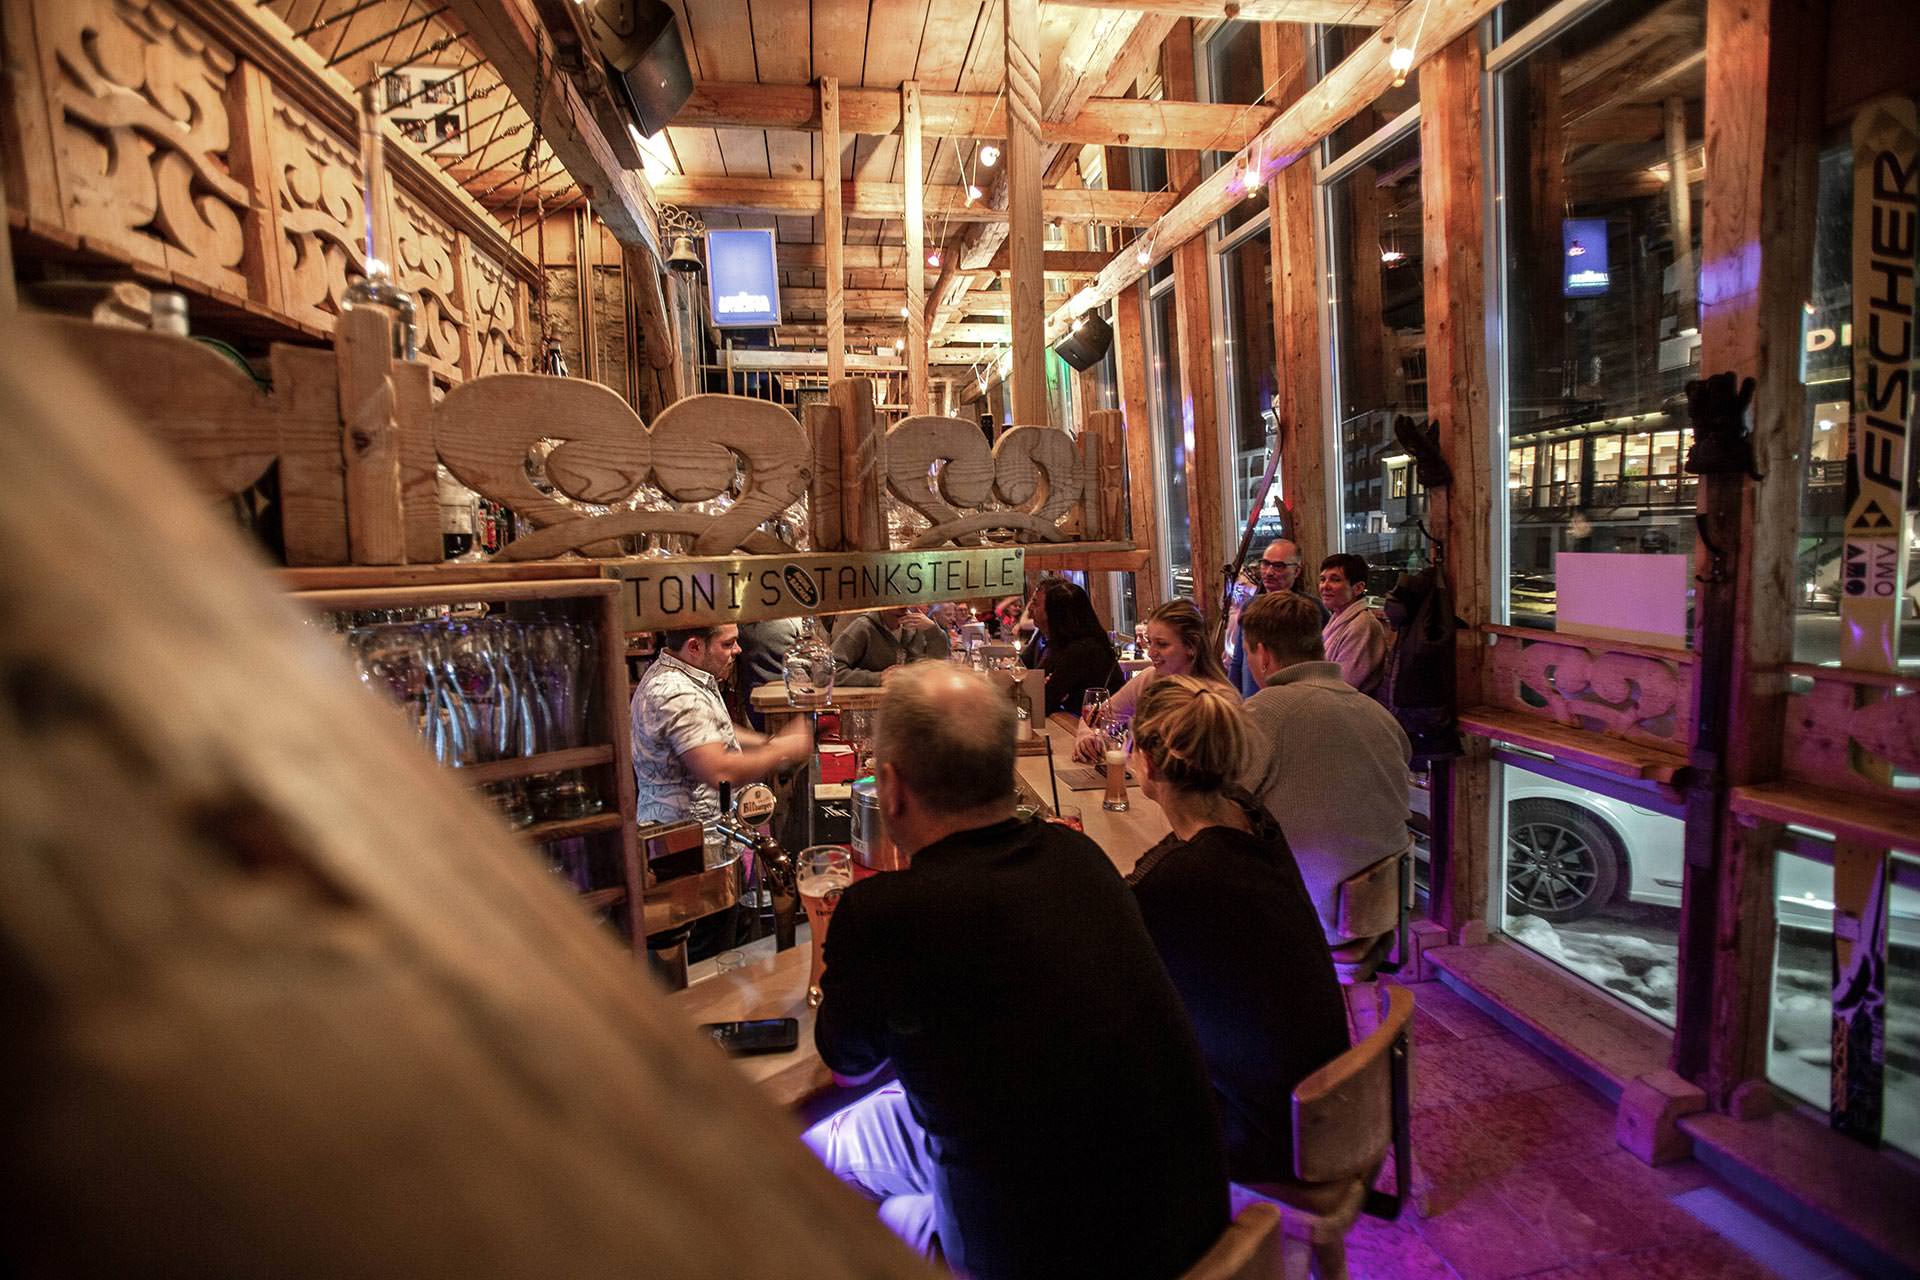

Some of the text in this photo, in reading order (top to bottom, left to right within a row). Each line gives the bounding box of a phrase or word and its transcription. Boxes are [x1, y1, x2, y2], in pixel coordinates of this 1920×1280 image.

[1864, 150, 1920, 492] FISCHER
[625, 569, 782, 617] TONI'S
[814, 556, 1016, 602] TANKSTELLE
[1873, 543, 1896, 596] OMV
